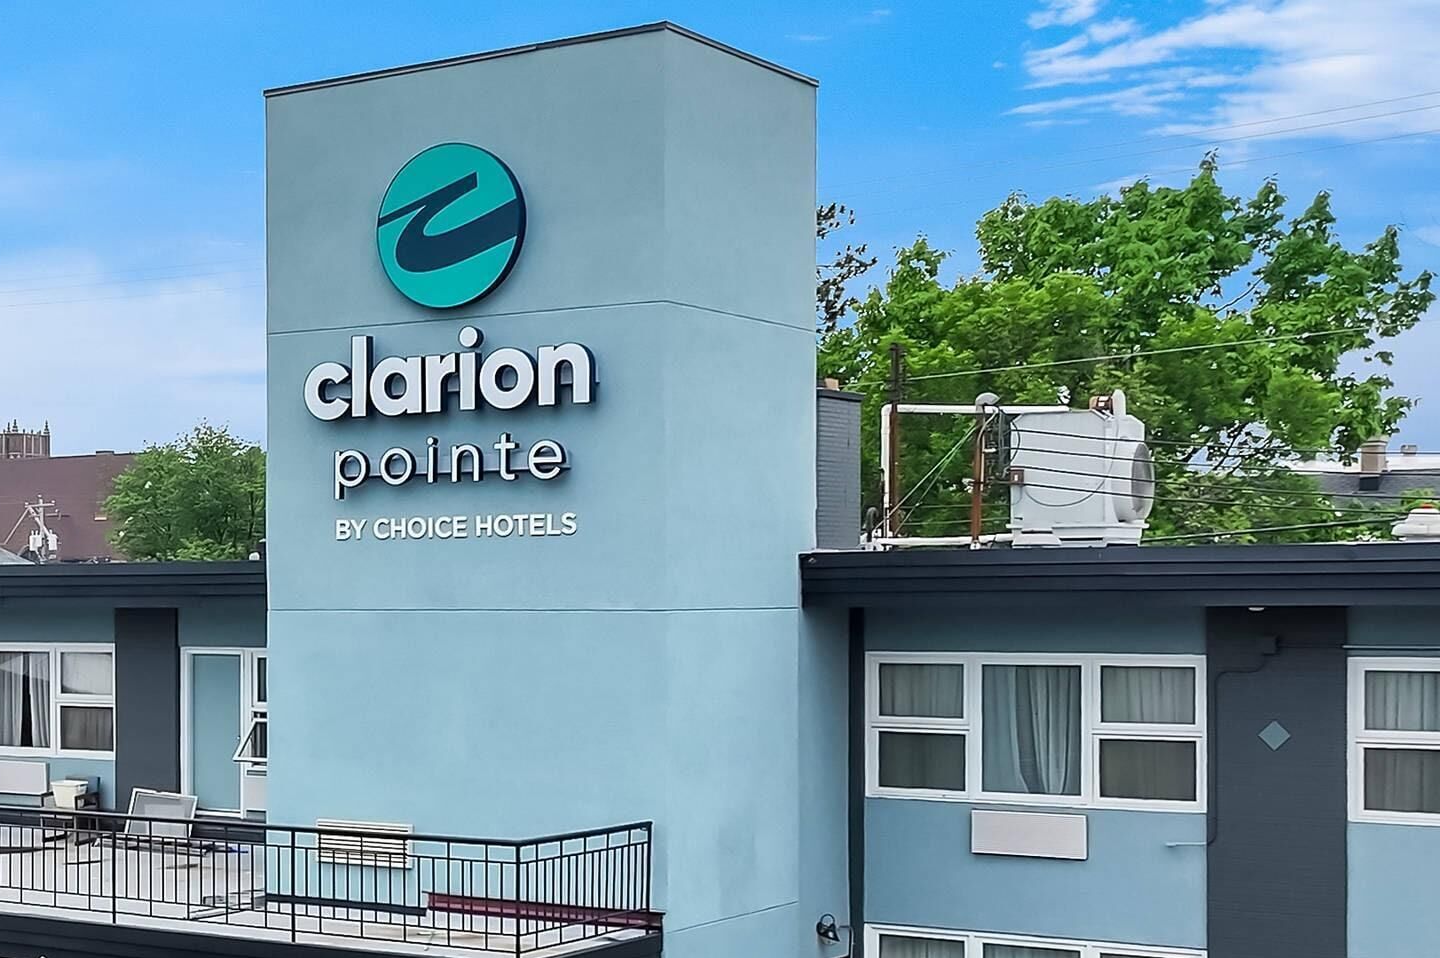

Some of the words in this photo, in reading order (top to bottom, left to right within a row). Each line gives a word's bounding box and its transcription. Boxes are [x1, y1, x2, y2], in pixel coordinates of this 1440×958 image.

[303, 325, 595, 421] clarion
[333, 432, 568, 500] pointe
[335, 518, 367, 541] BY
[373, 515, 468, 540] CHOICE
[475, 512, 578, 537] HOTELS
